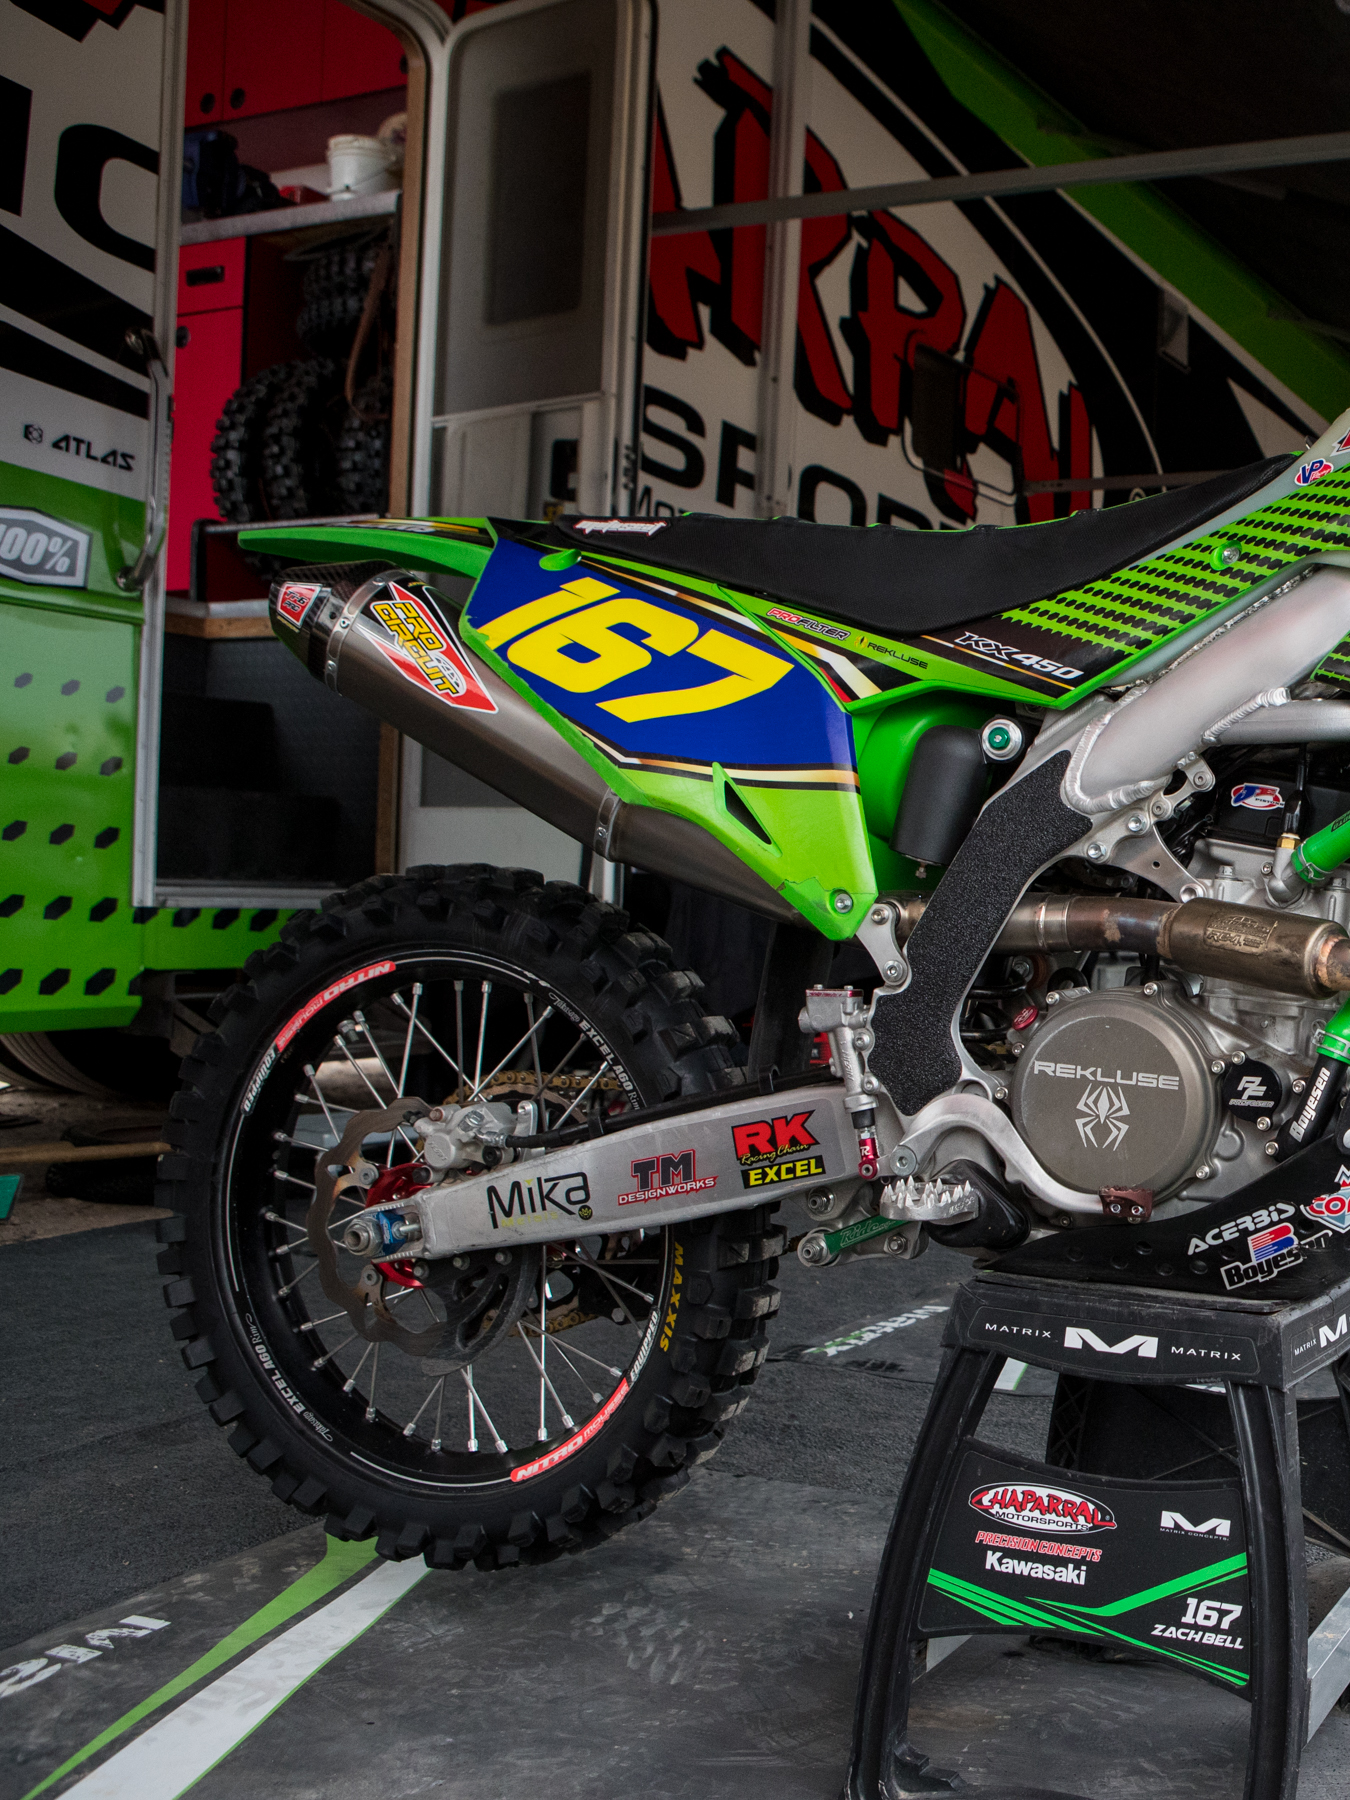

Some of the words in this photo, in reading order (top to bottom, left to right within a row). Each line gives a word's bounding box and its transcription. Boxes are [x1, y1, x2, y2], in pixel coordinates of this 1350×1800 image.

[51, 433, 136, 473] ATLAS
[394, 602, 444, 651] PRO
[767, 607, 852, 641] PROFILTER
[373, 602, 460, 696] CIRCUIT
[475, 576, 794, 723] 167
[867, 641, 929, 669] REKLUSE
[322, 962, 391, 1002] NITRO
[579, 1019, 616, 1065] EXCEL
[612, 1064, 634, 1094] A60
[1033, 1060, 1180, 1091] REKLUSE
[243, 1047, 277, 1113] EQUIPPED
[1288, 1066, 1332, 1143] Boyesen
[732, 1109, 817, 1160] RK
[739, 1151, 777, 1165] Racing
[776, 1143, 809, 1160] Chain
[618, 1176, 715, 1205] DESIGNWORKS
[632, 1149, 695, 1192] TM
[748, 1157, 824, 1187] EXCEL
[486, 1171, 591, 1230] Mika
[659, 1241, 685, 1353] MAXXIS
[254, 1343, 277, 1370] A60
[984, 1321, 1053, 1339] MATRIX
[1170, 1345, 1242, 1361] MATRIX
[1293, 1338, 1318, 1357] MATRIX
[271, 1369, 307, 1415] EXCEL
[515, 1434, 584, 1481] NITRO
[582, 1384, 630, 1441] MOUSSE
[629, 1309, 659, 1383] EQUIPPED
[971, 1487, 1117, 1529] CHAPARRAL
[994, 1509, 1090, 1532] MOTORSPORTS
[975, 1529, 1040, 1553] PRECISION
[1037, 1541, 1102, 1563] CONCEPTS
[1159, 1526, 1186, 1537] MATRIX
[984, 1549, 1087, 1586] Kawasaki
[1180, 1596, 1243, 1631] 167
[1150, 1623, 1203, 1643] ZACH
[1201, 1632, 1245, 1651] BELL
